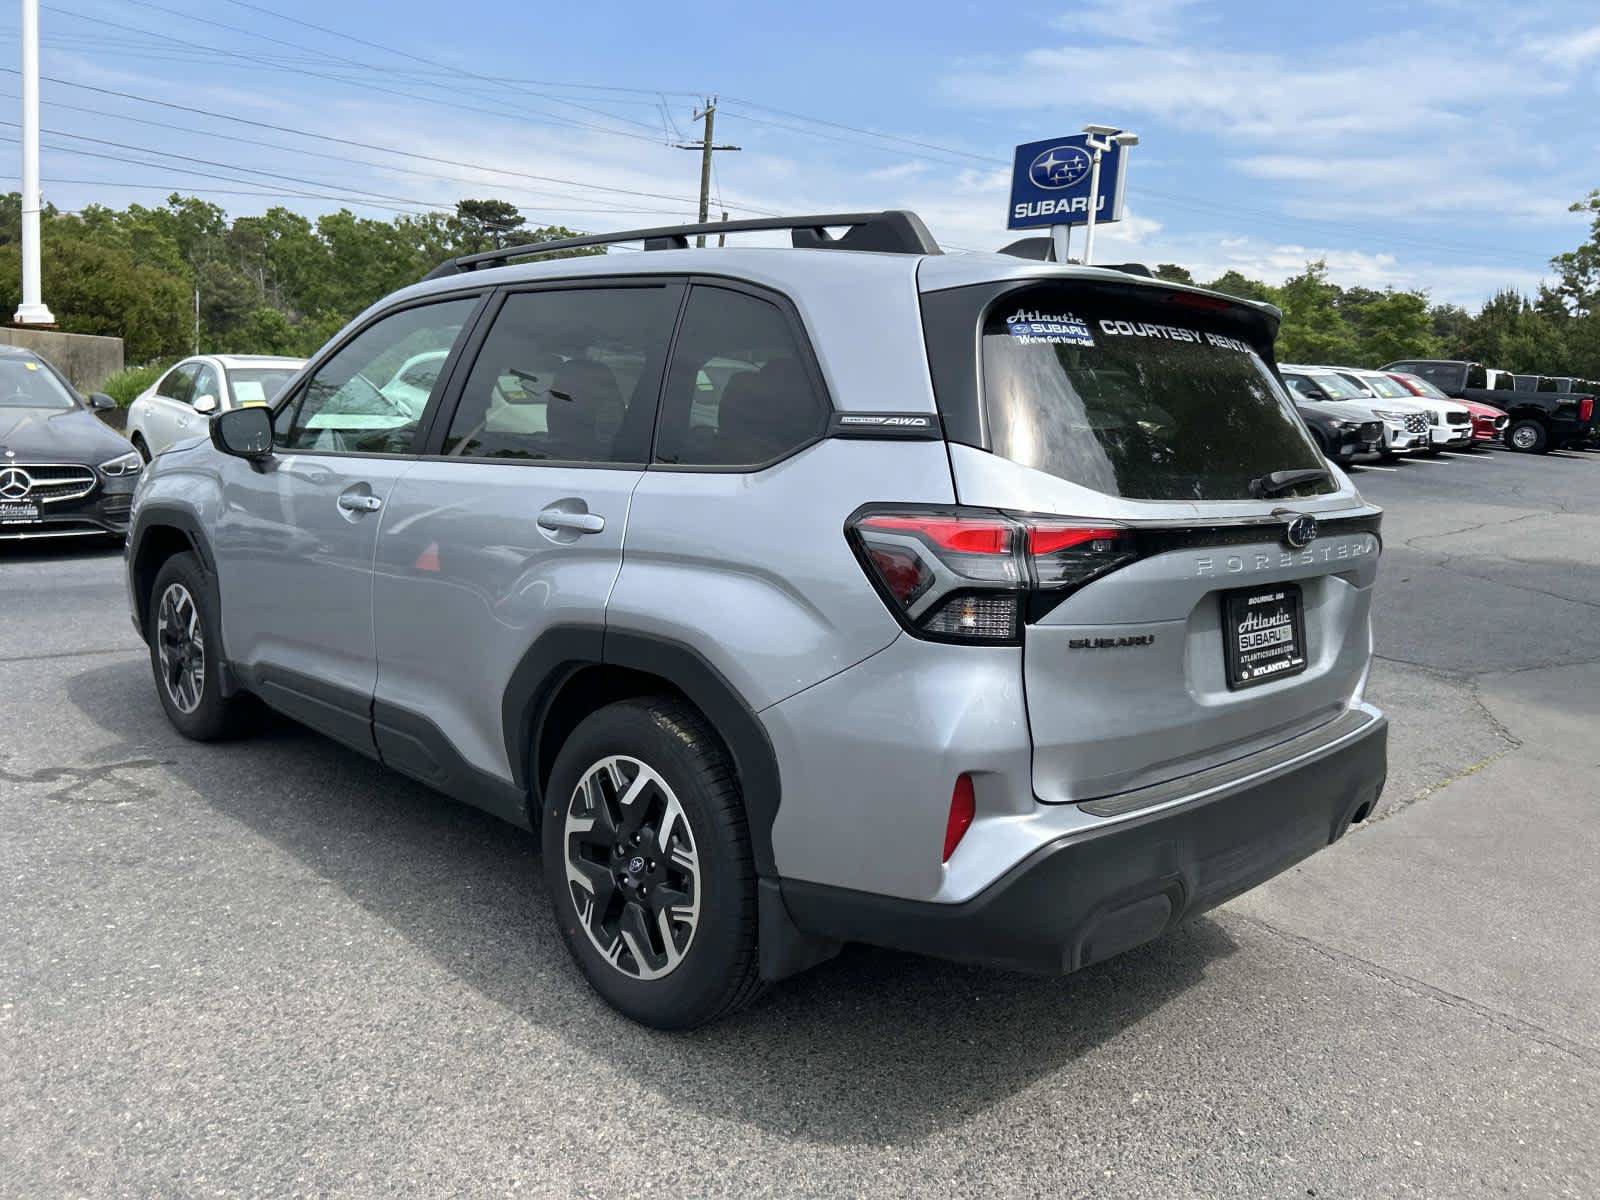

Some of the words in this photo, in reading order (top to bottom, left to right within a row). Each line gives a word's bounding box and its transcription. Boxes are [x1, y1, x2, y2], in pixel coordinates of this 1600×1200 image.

[1015, 196, 1105, 218] SUBARU
[1006, 309, 1087, 325] Atlantic
[1030, 323, 1089, 336] SUBARU
[1099, 319, 1202, 343] COURTESY
[881, 417, 927, 426] AWD
[1196, 542, 1363, 575] FORESTER
[1239, 607, 1291, 633] Atlantic
[1069, 635, 1154, 648] SUBARU
[1240, 629, 1281, 649] SUBARU
[1253, 661, 1290, 677] ATLANTIC
